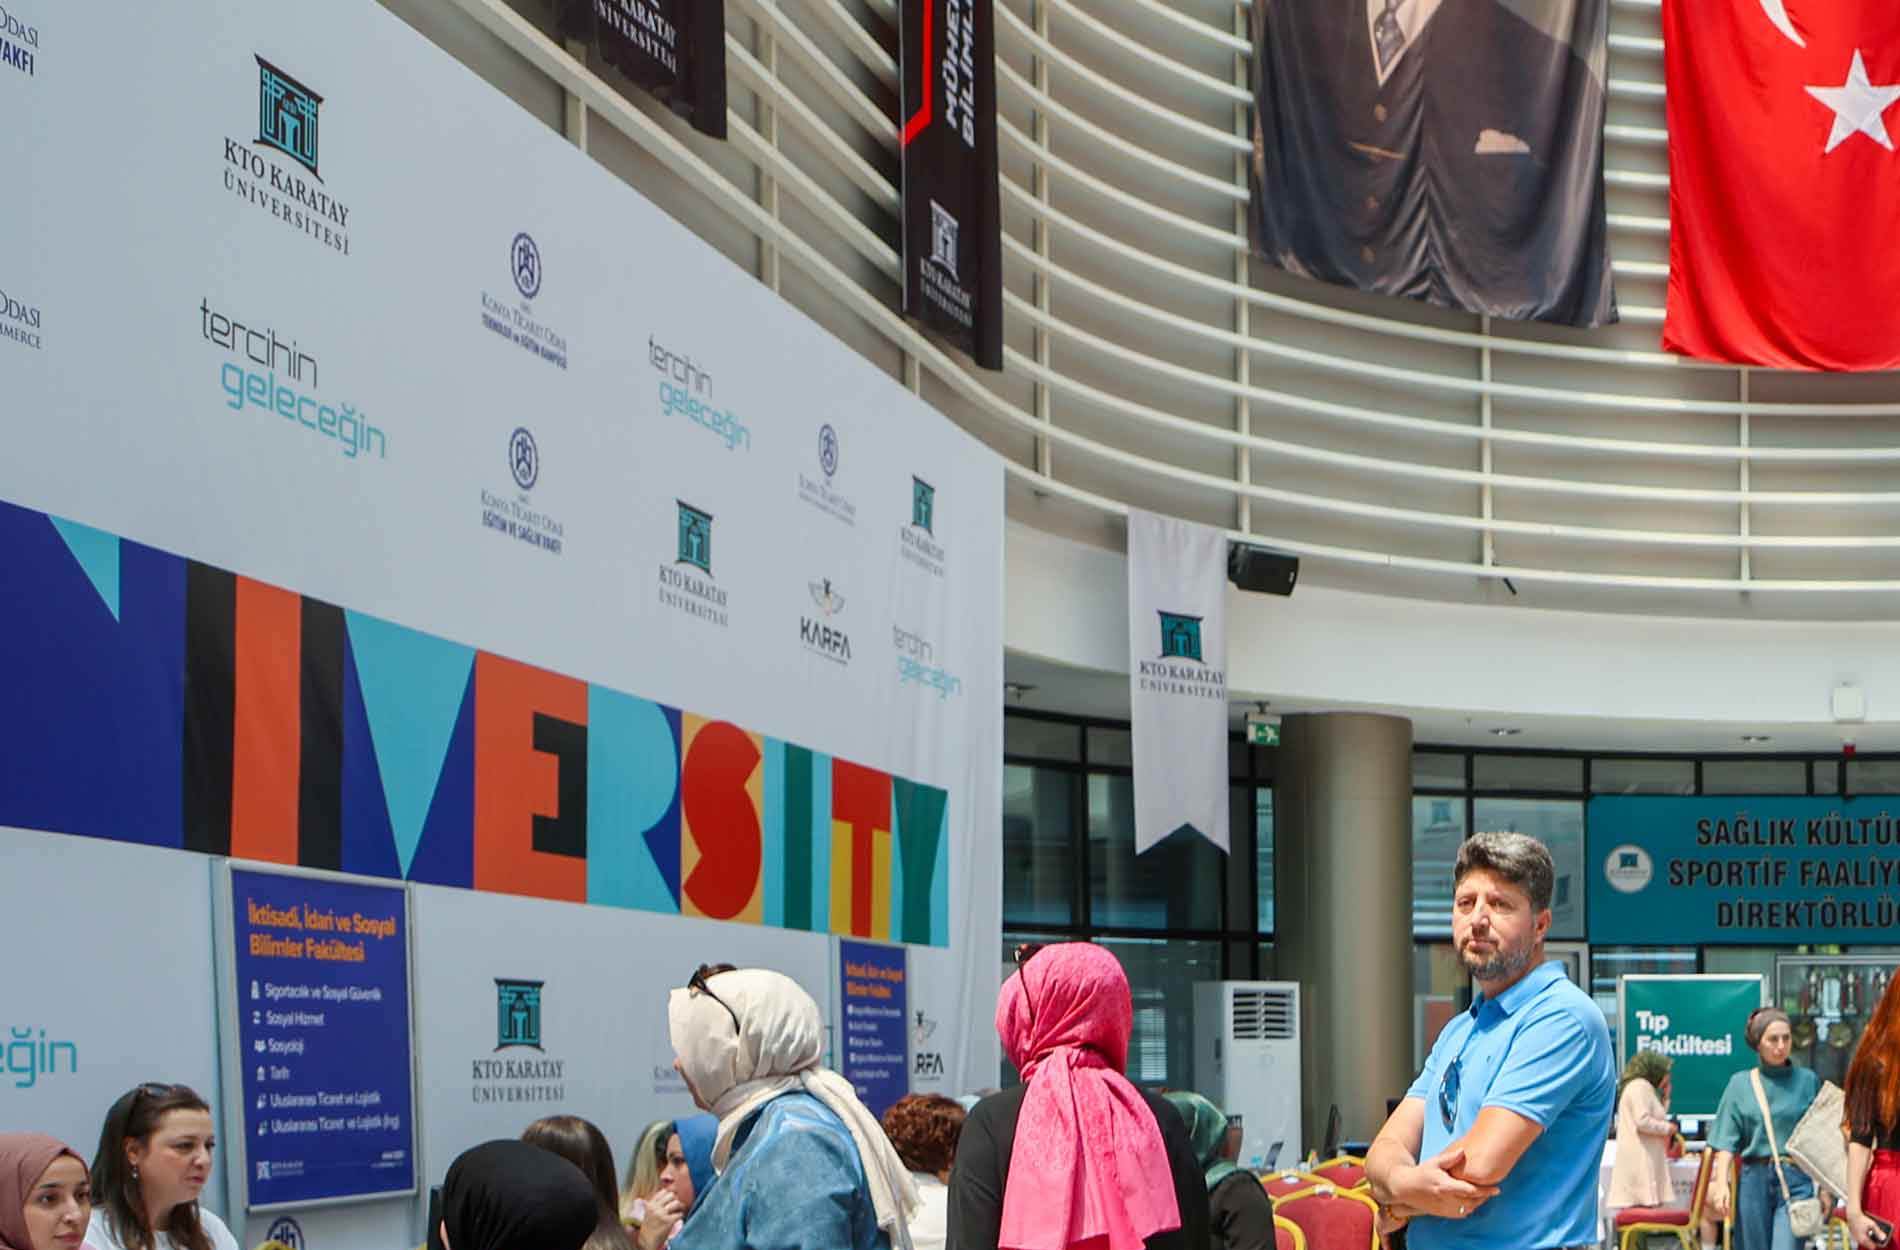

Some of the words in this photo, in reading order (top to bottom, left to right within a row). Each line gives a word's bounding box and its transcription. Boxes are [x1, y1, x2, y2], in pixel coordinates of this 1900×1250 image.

[223, 136, 265, 179] KTO
[270, 163, 350, 228] KARATAY
[223, 167, 350, 256] ÜNİVERSİTESİ
[200, 296, 318, 389] tercihin
[221, 362, 386, 460] geleceğin
[800, 615, 852, 660] KARFA
[1169, 665, 1224, 685] KARATAY
[1696, 812, 1796, 846] SAĞLIK
[1668, 855, 1787, 888] SPORTİF
[352, 913, 396, 940] Sosyal
[250, 934, 303, 958] Bilimler
[305, 937, 365, 963] Fakültesi
[1635, 1010, 1670, 1035] Tıp
[1636, 1033, 1733, 1056] Fakültesi
[471, 1059, 503, 1079] KTO
[506, 1059, 565, 1079] KARATAY
